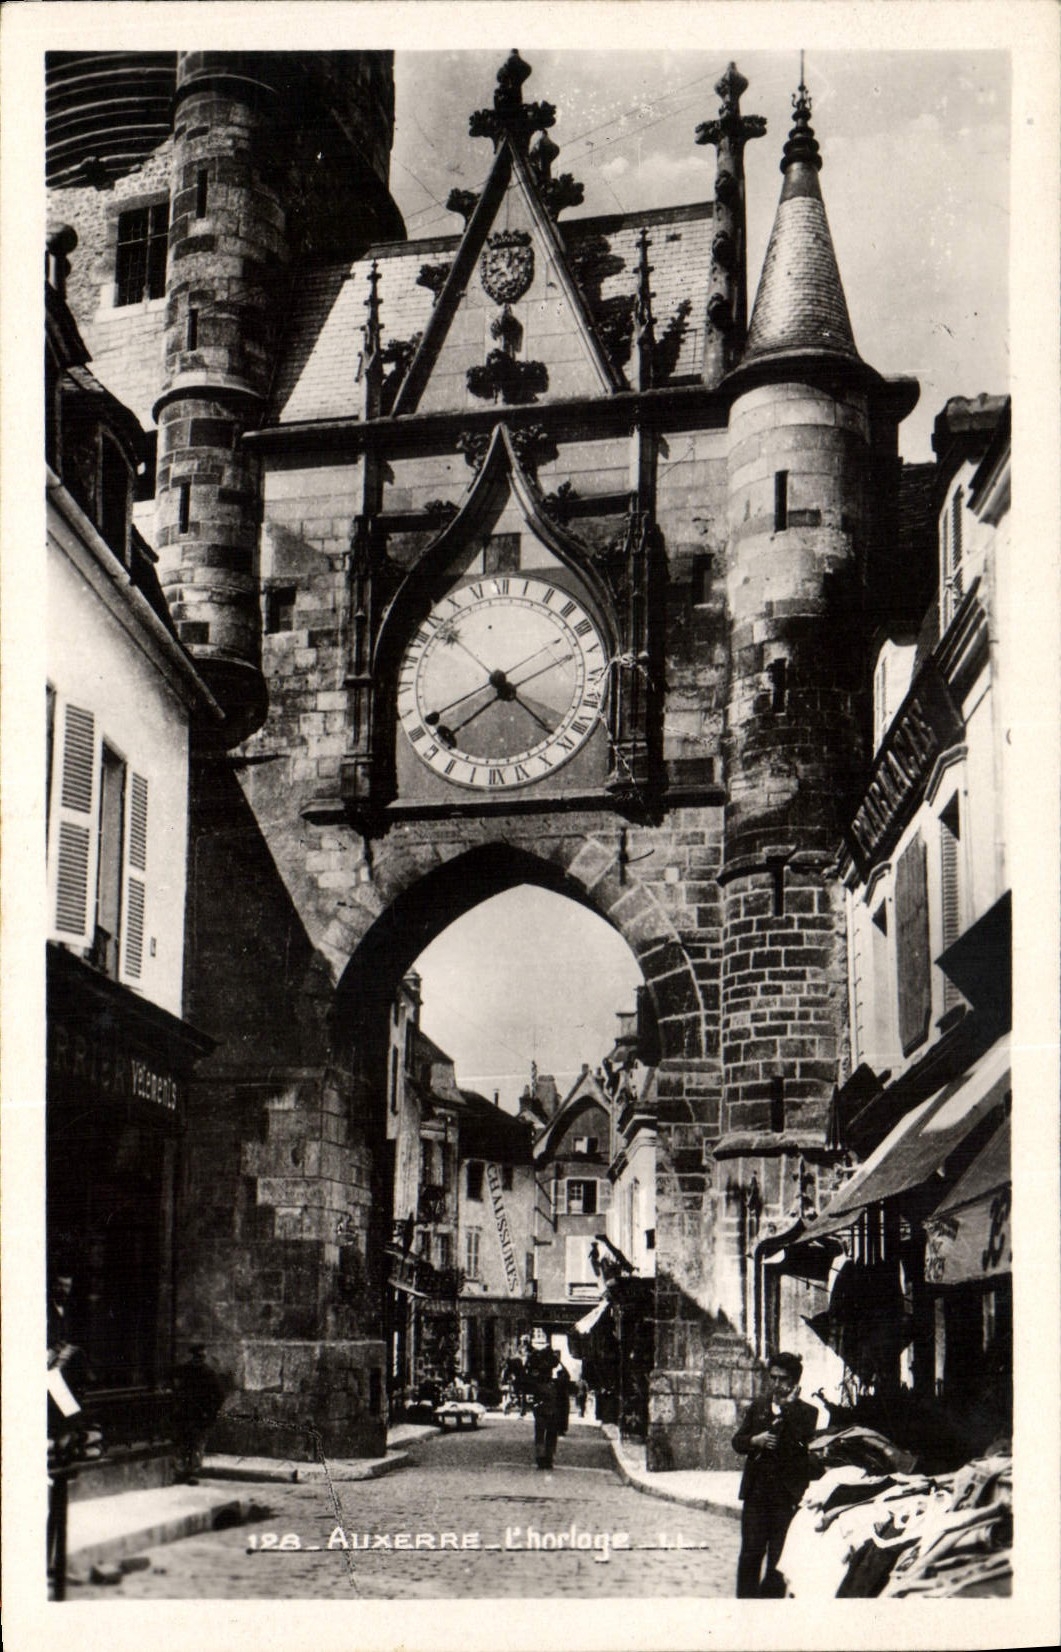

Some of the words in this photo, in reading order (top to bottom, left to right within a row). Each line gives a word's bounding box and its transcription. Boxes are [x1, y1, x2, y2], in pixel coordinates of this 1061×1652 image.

[524, 581, 529, 596] I
[542, 588, 555, 604] II
[560, 601, 577, 618] III
[444, 759, 457, 775] II
[470, 767, 477, 783] I
[487, 1164, 518, 1292] CHAUSSURES
